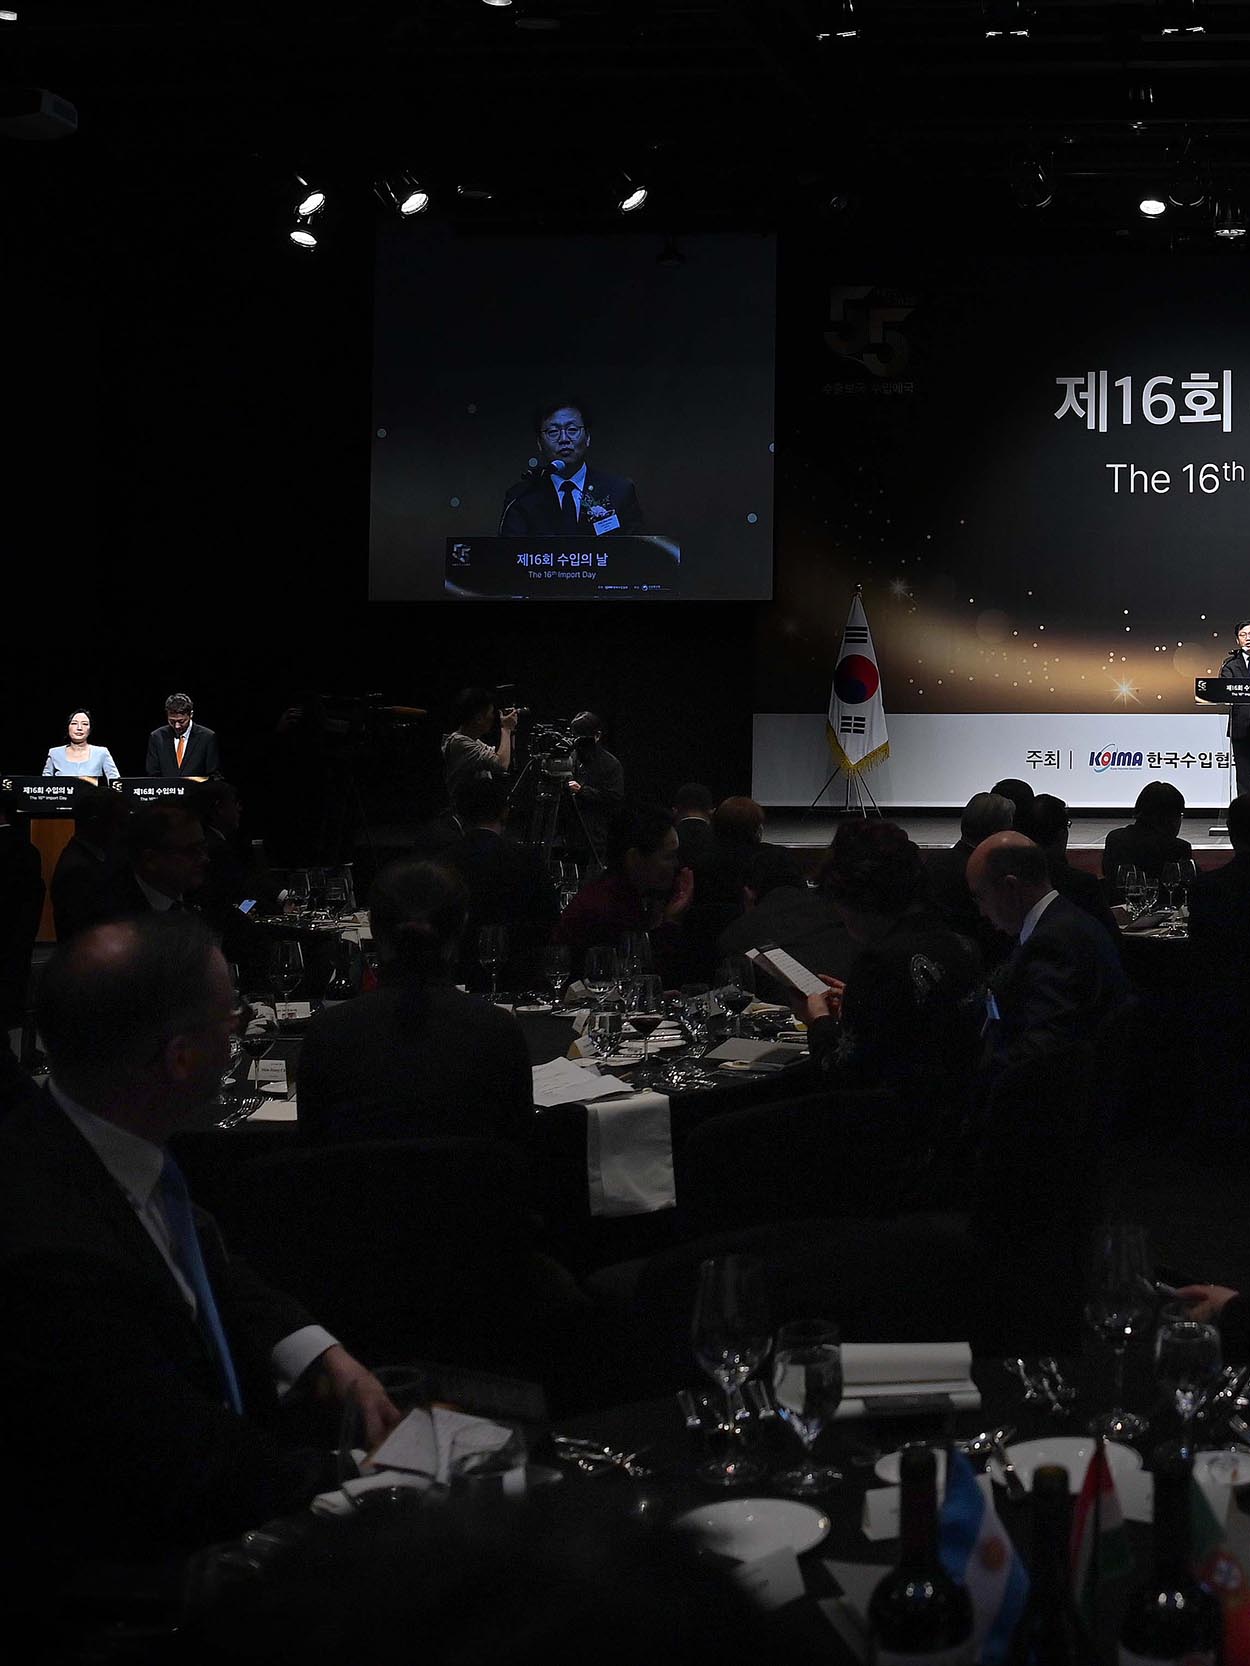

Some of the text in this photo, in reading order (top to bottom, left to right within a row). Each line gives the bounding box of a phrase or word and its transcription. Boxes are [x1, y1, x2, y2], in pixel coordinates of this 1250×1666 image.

[1054, 369, 1232, 433] 제16회
[1106, 463, 1171, 494] The
[1182, 460, 1246, 494] 16th
[516, 552, 609, 567] 제16회 수입의 날
[528, 570, 543, 579] The
[558, 570, 581, 580] Import
[582, 570, 597, 580] Day
[1025, 749, 1060, 770] 주최
[1089, 751, 1144, 767] KOIMA
[45, 786, 66, 795] 수입의
[155, 787, 176, 796] 수입의
